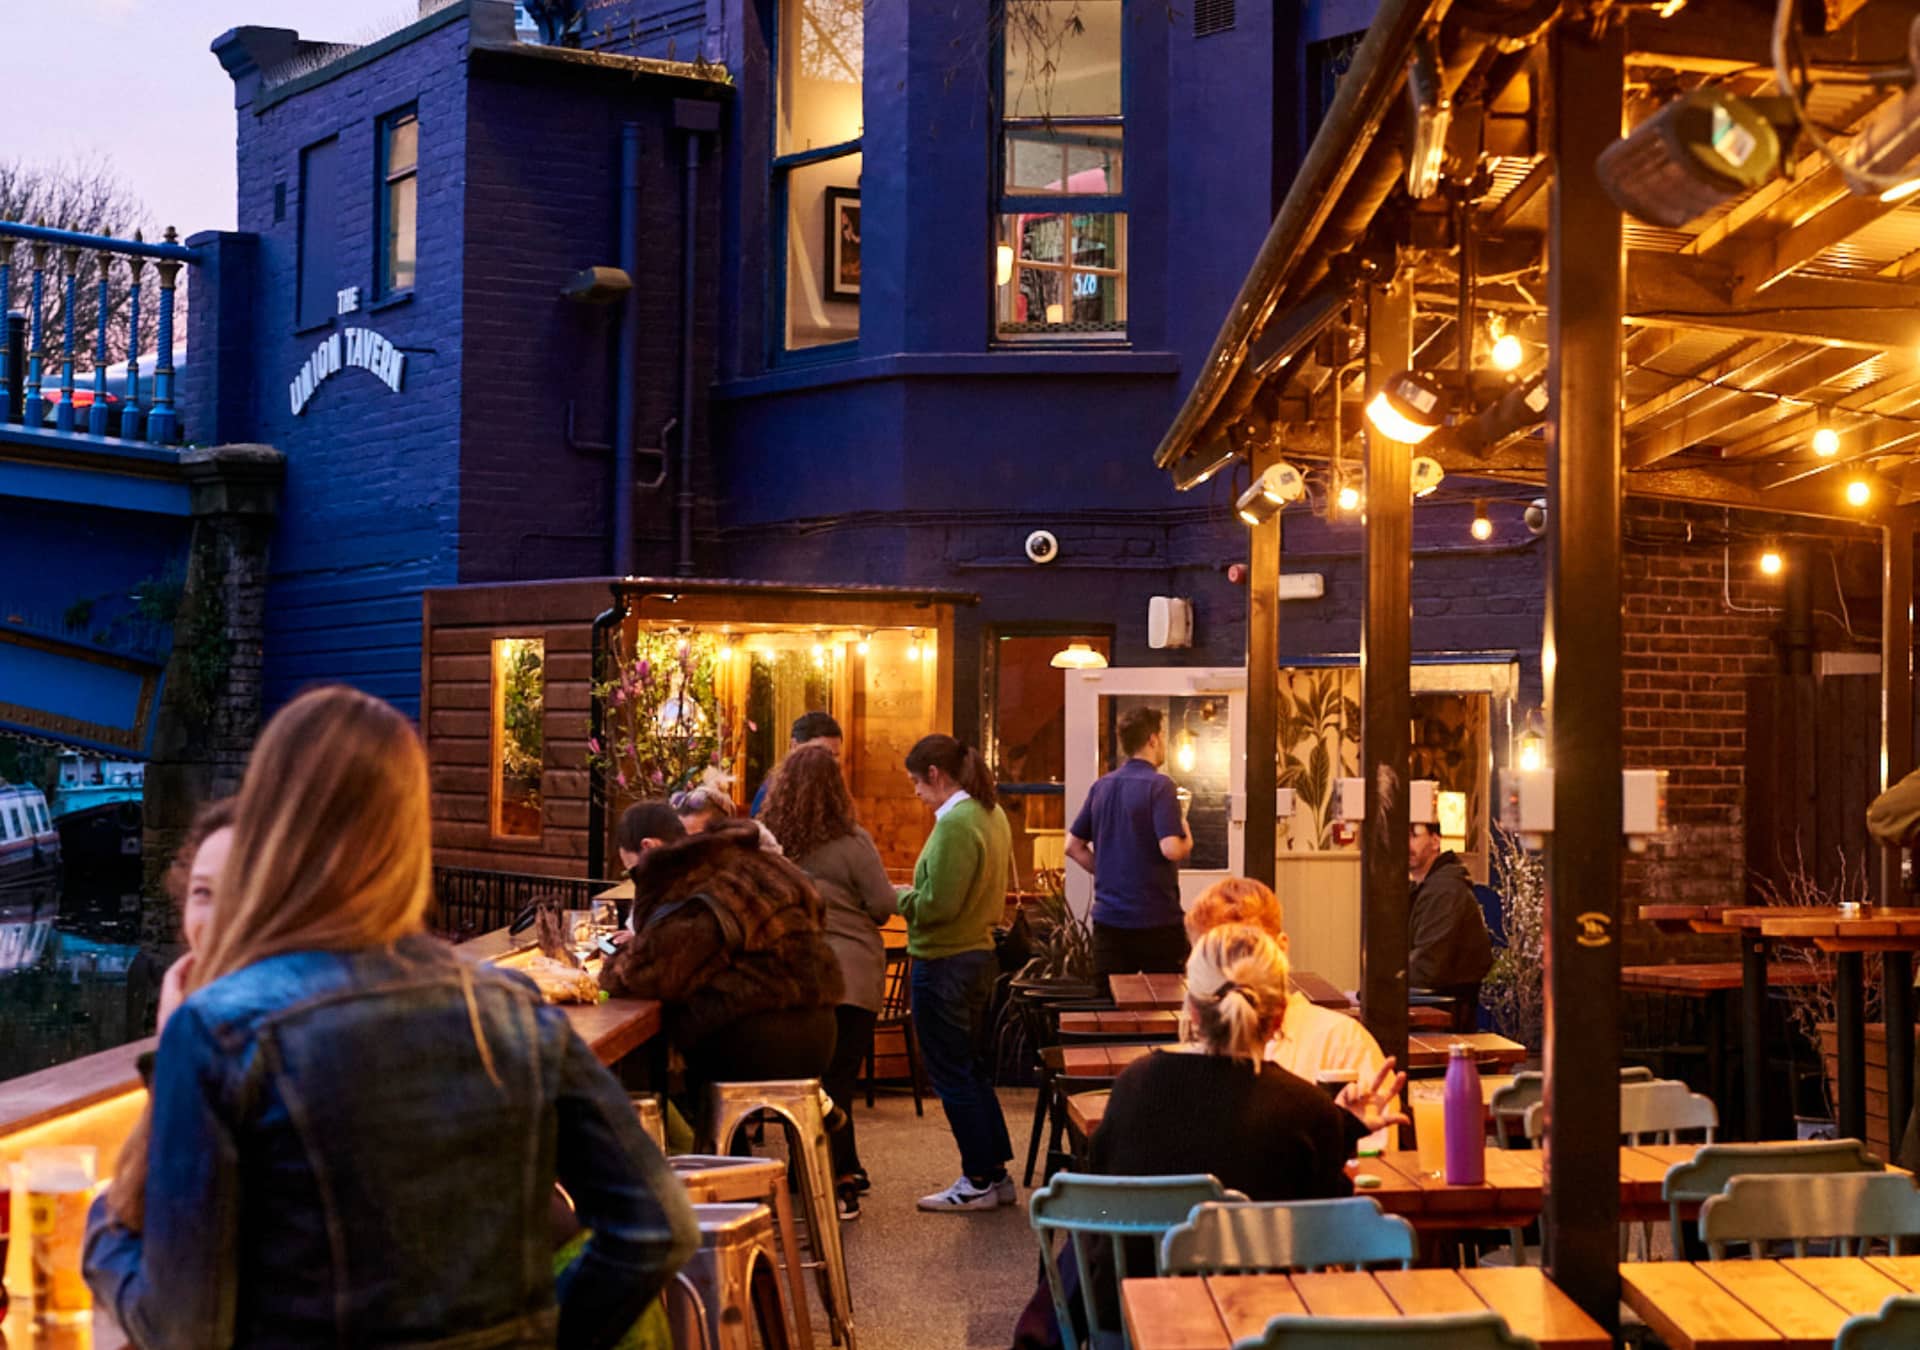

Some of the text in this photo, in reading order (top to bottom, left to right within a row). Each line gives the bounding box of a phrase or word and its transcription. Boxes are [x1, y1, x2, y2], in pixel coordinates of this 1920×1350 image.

[337, 286, 360, 315] THE
[289, 327, 405, 416] UNION TAVERN
